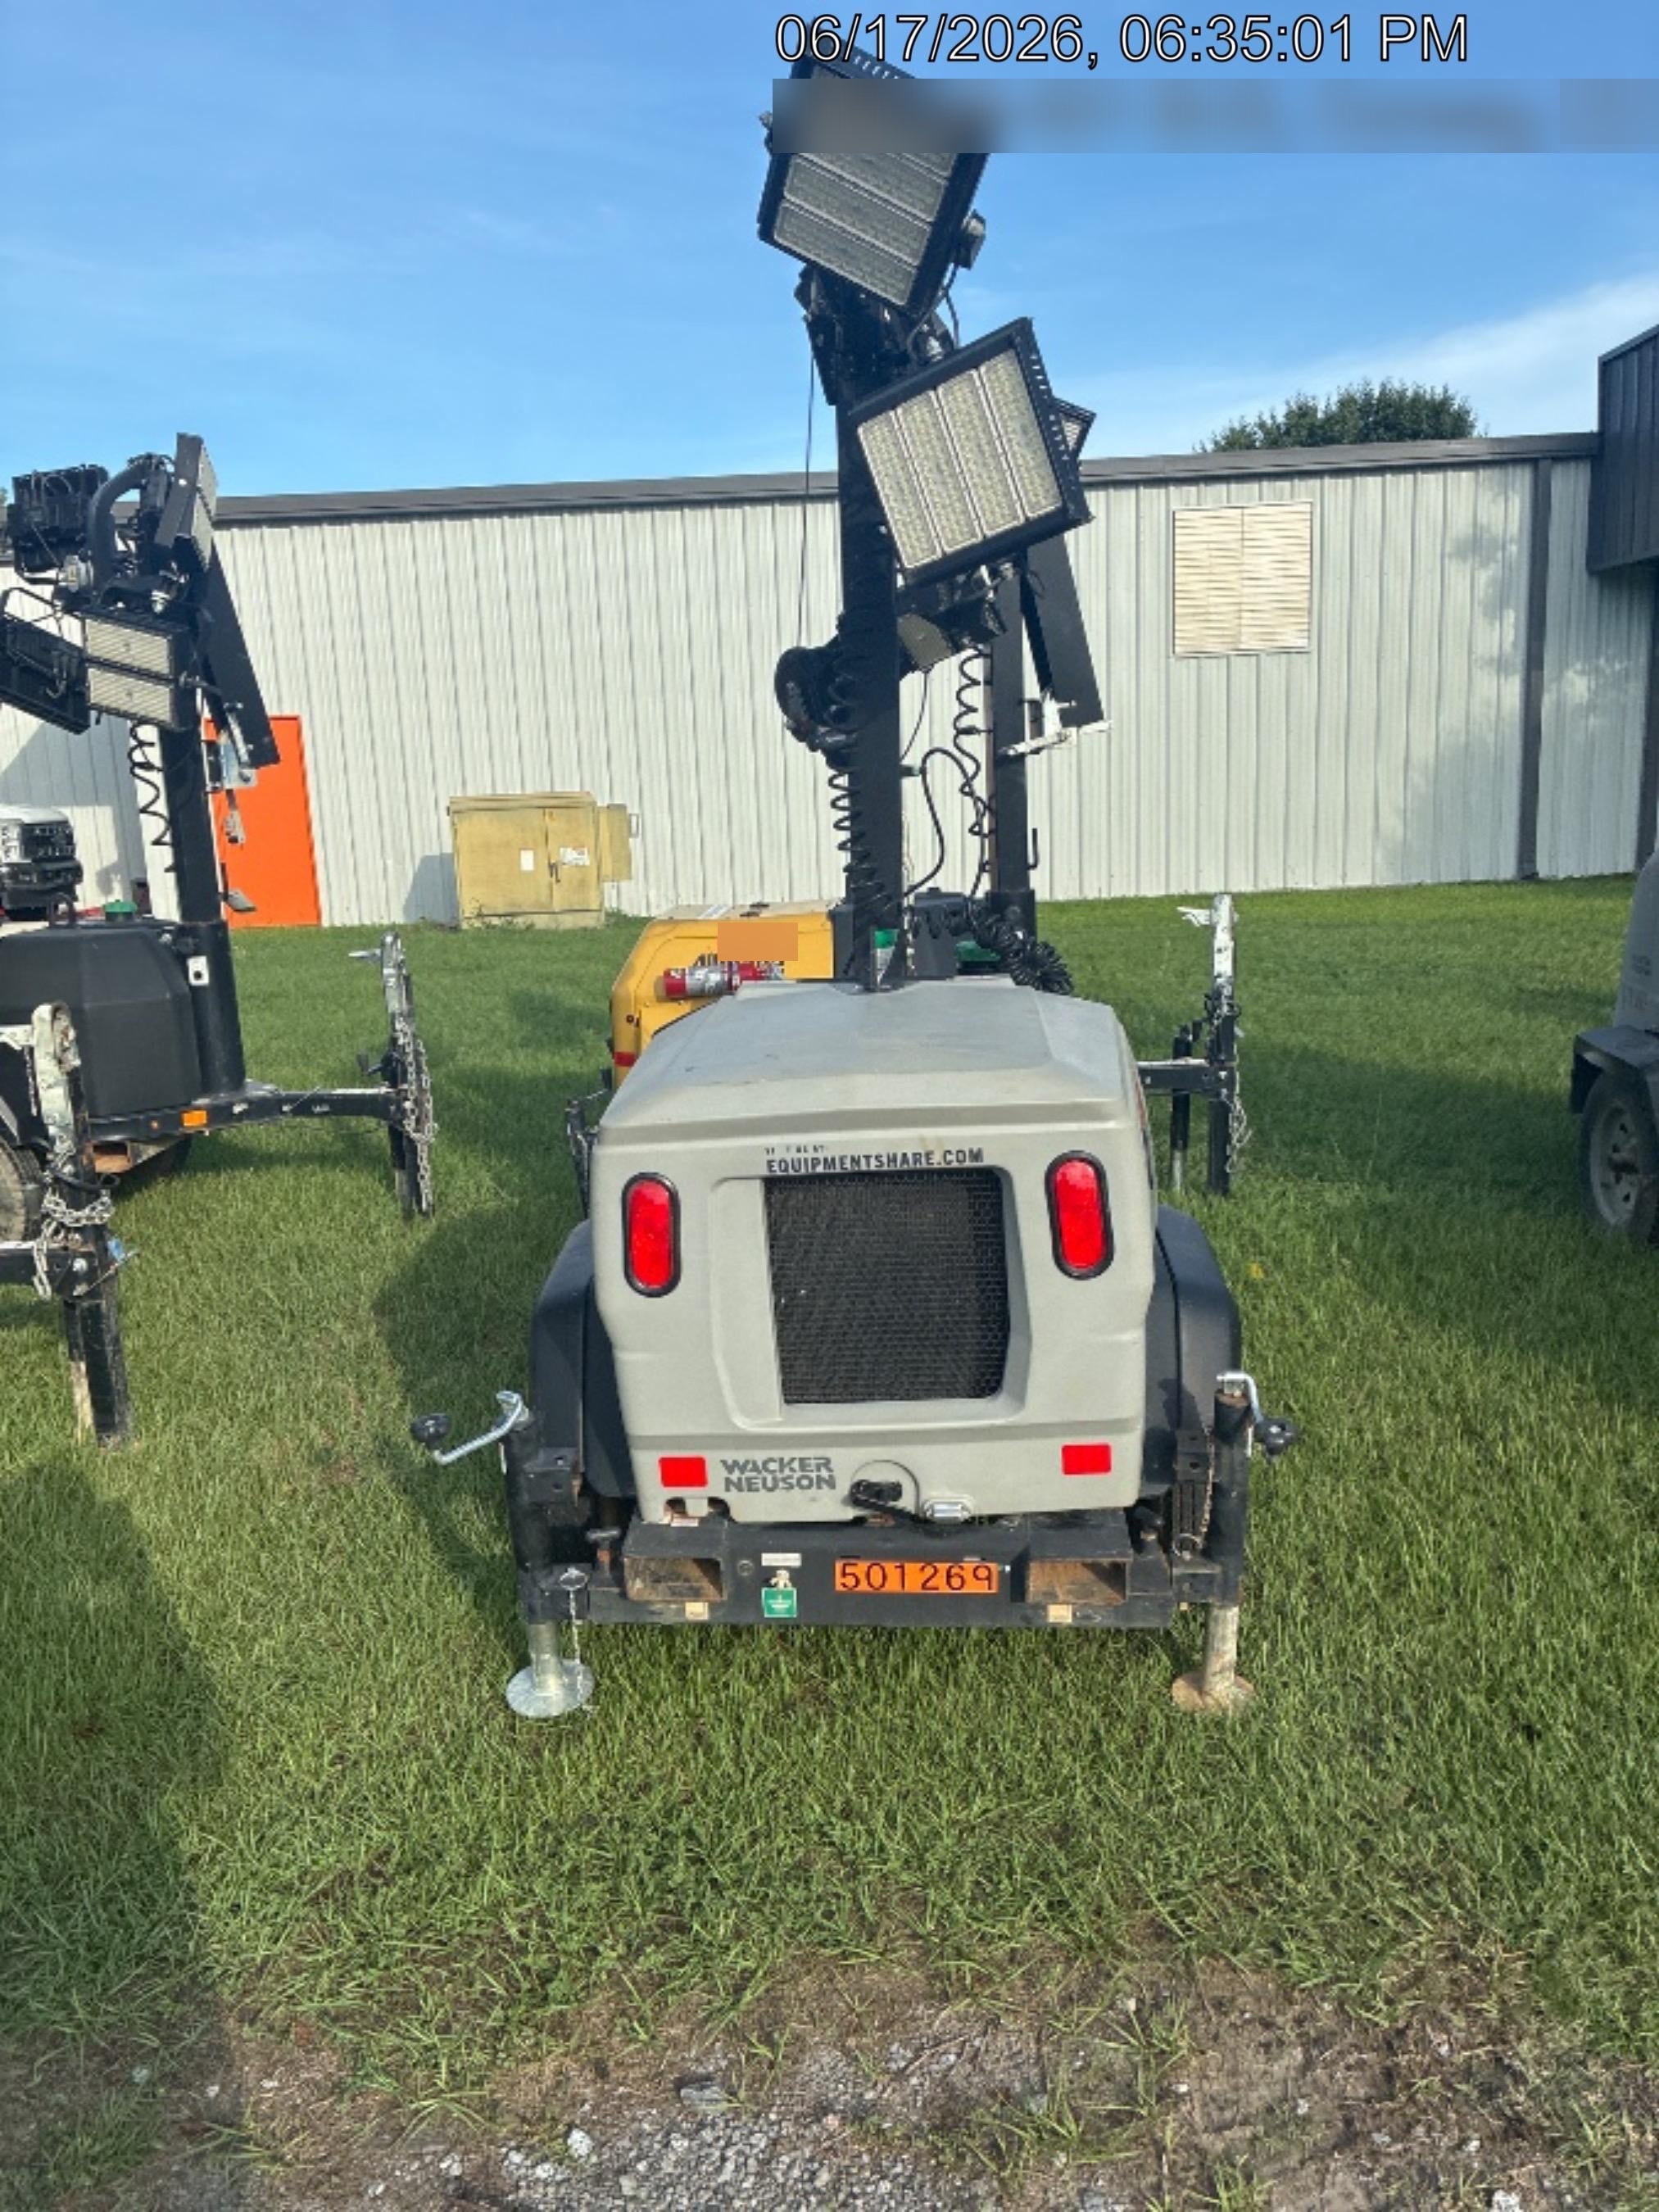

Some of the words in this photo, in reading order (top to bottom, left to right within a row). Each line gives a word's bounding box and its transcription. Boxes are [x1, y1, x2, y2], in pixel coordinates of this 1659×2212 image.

[766, 1148, 984, 1173] EQUIPMENTSHARE.COM
[720, 1457, 834, 1475] WACKER
[724, 1474, 836, 1492] NEUSON
[841, 1562, 993, 1591] 501269
